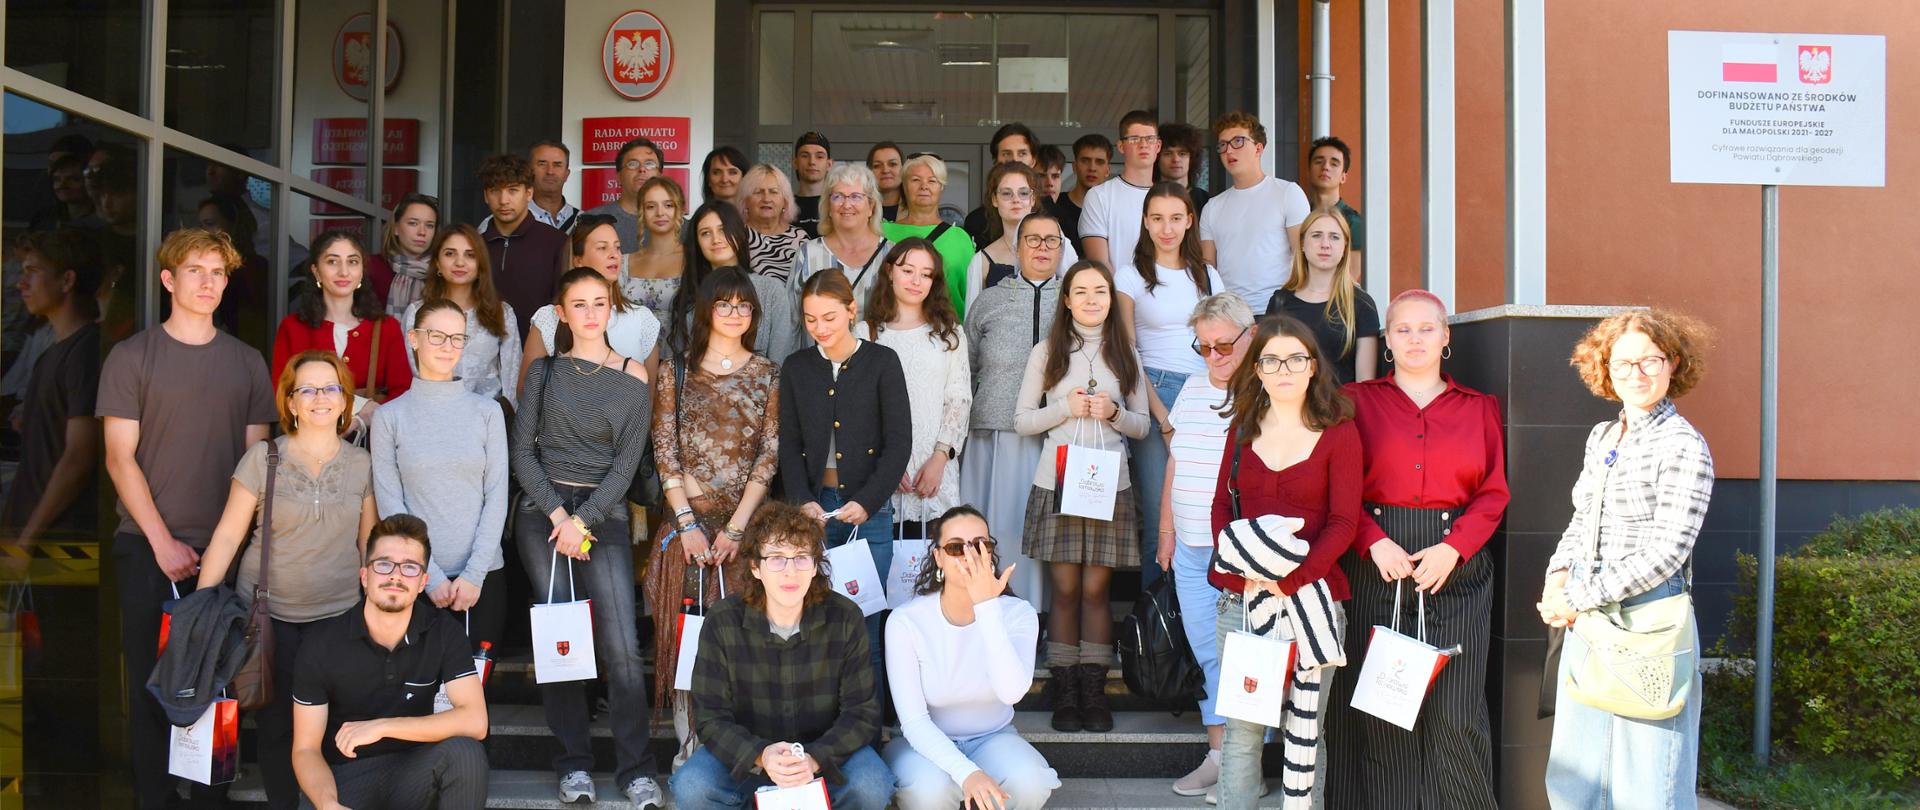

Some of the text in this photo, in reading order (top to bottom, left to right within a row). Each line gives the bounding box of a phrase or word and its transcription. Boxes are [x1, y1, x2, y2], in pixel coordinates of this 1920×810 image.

[1698, 90, 1857, 102] DOFINANSOWANO ZE ŚRODKÓW
[1729, 101, 1826, 112] BUDŻETU PAŃSTWA
[1730, 119, 1825, 128] FUNDUSZE EUROPEJSKIE
[594, 127, 676, 138] RADA POWIATU
[1739, 128, 1790, 136] MAŁOPOLSKI
[1814, 129, 1833, 137] 2027
[1711, 144, 1844, 155] Cyfrowe rozwiązania dla geodezji
[1733, 153, 1824, 164] Powiatu Dąbrowskiego
